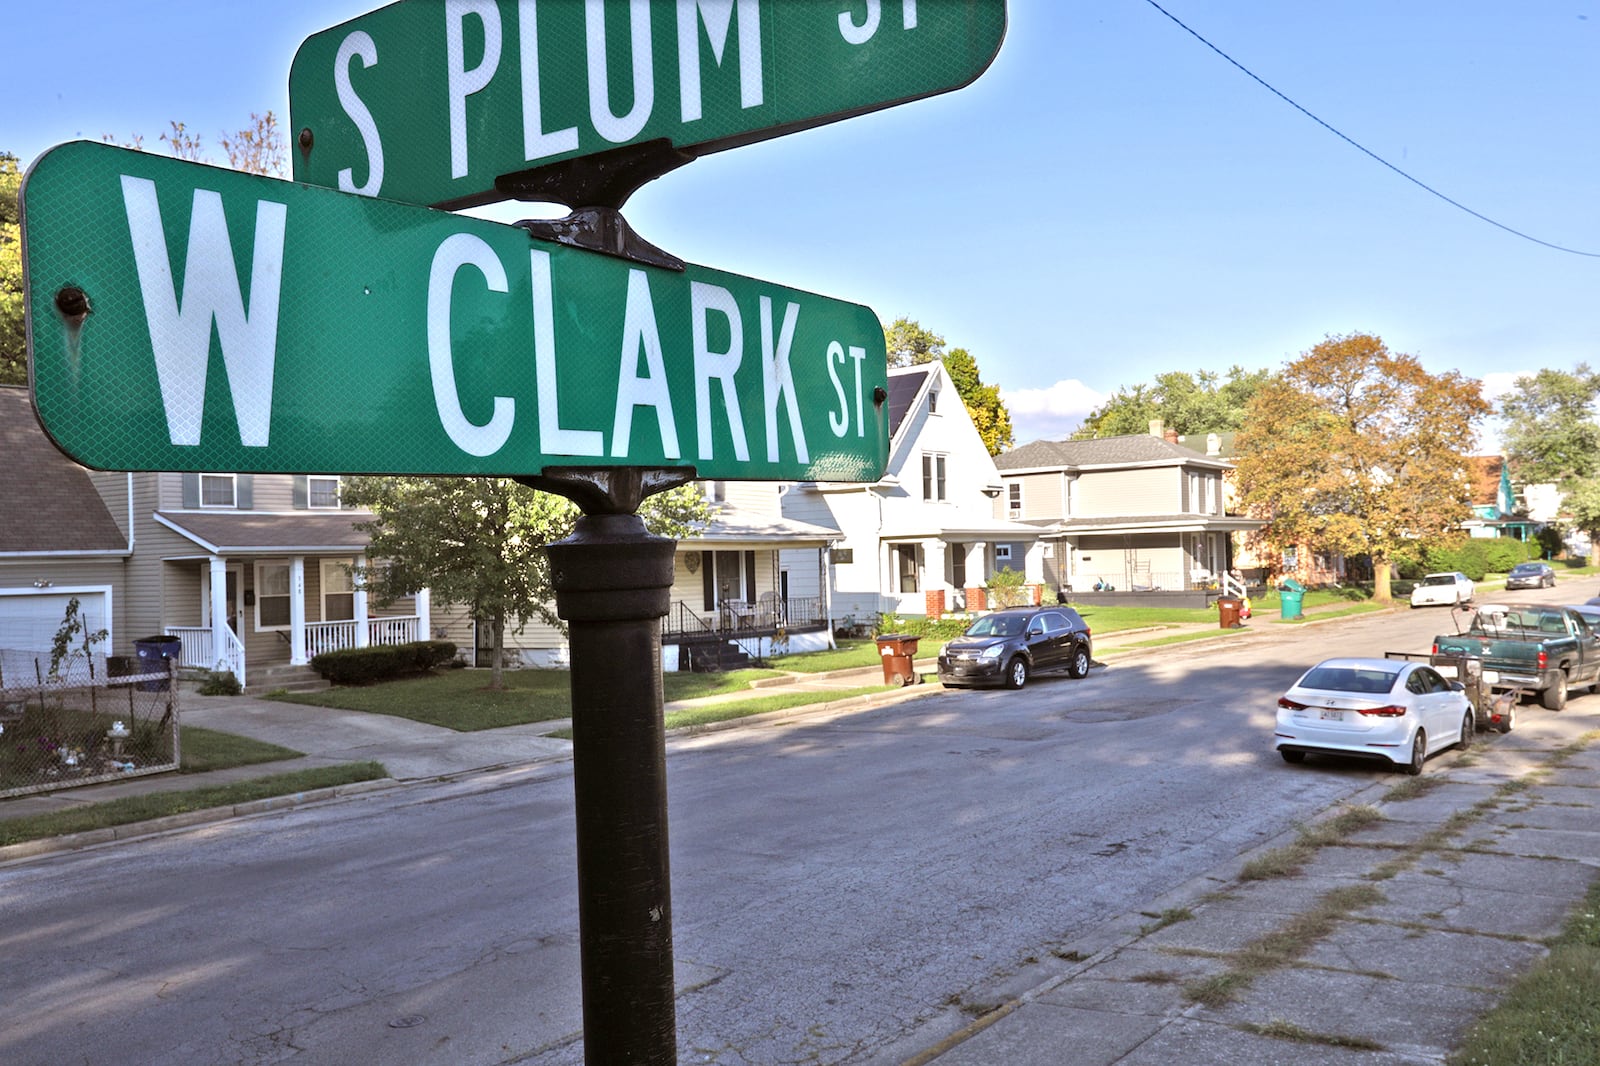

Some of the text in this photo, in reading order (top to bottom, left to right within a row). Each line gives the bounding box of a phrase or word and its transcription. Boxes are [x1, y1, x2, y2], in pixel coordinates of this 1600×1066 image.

[334, 30, 385, 197] S
[119, 174, 867, 465] W CLARK ST
